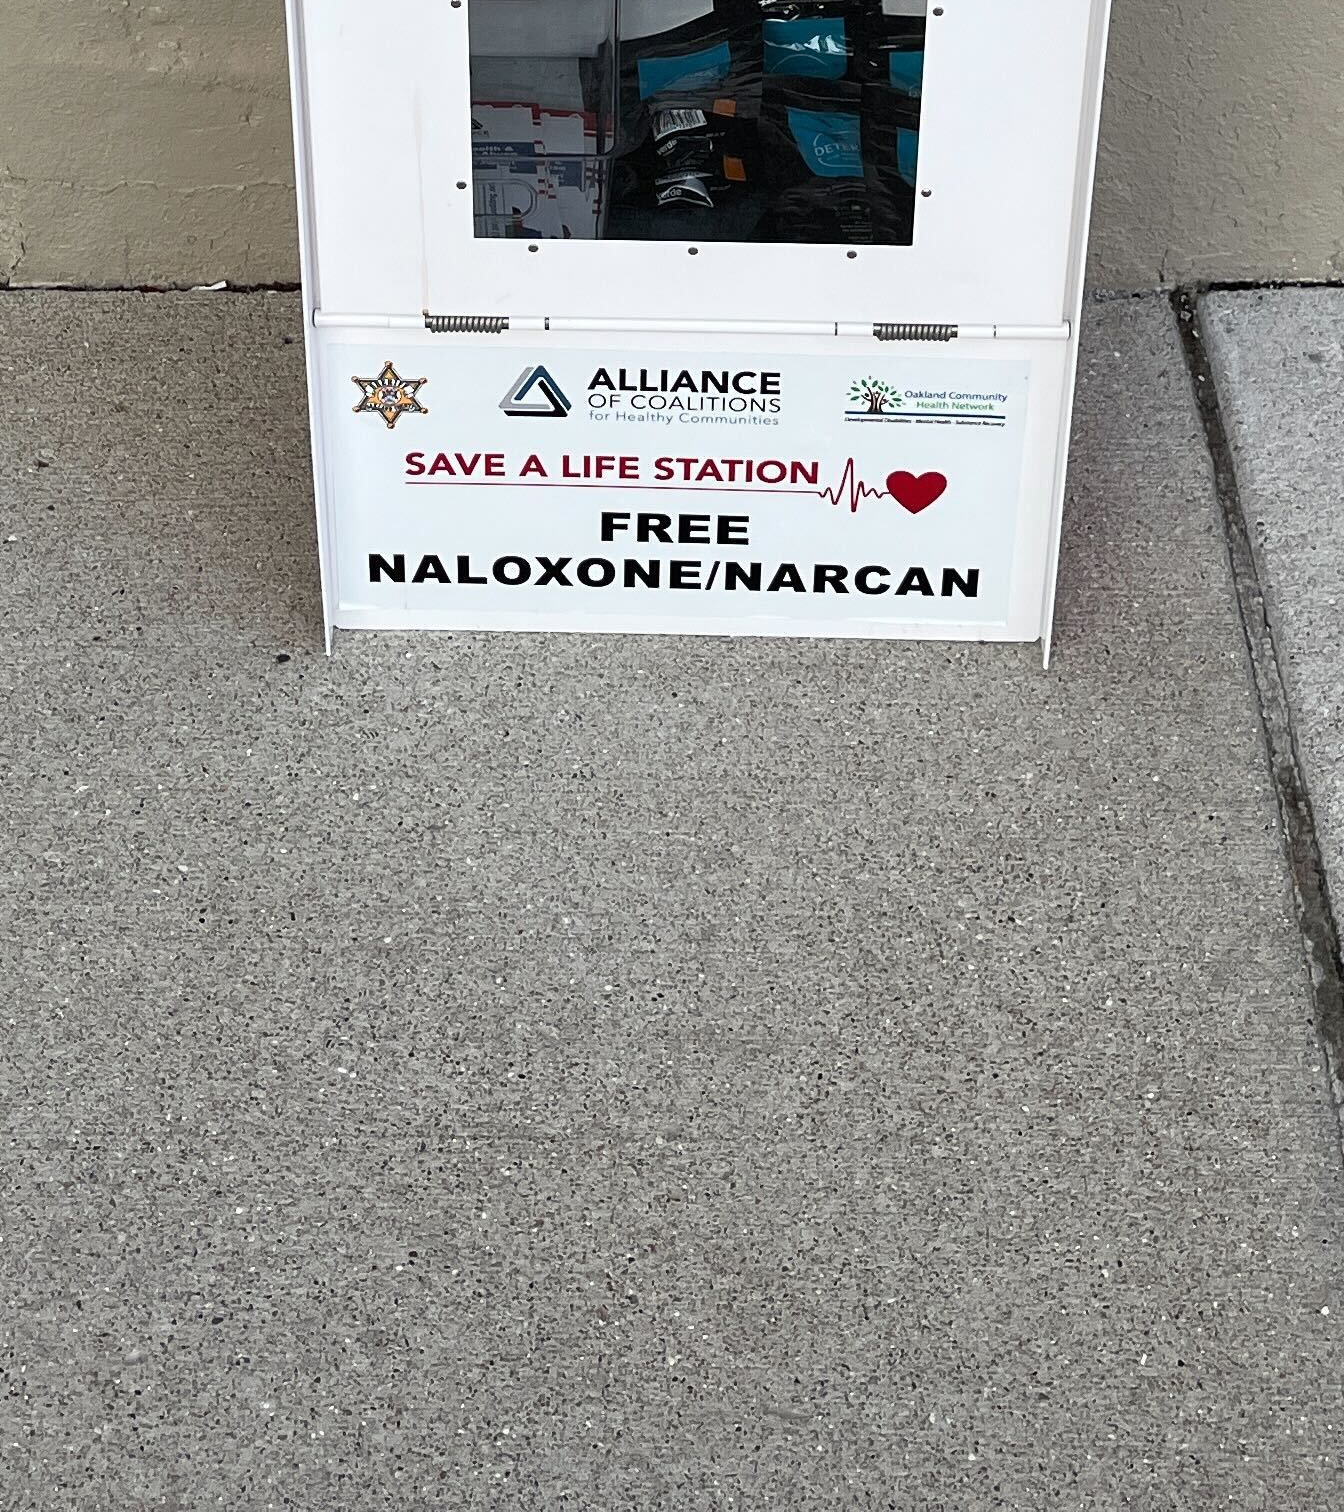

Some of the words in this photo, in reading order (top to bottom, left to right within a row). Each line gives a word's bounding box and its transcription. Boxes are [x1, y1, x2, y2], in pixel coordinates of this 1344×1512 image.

[587, 367, 781, 395] ALLIANCE
[588, 393, 621, 409] OF
[630, 394, 781, 413] COALITIONS
[904, 390, 946, 400] Oakland
[948, 391, 1008, 402] Community
[916, 401, 949, 410] Health
[951, 402, 995, 411] Network
[589, 410, 609, 421] for
[616, 411, 673, 425] Healthy
[679, 412, 779, 426] Communities
[405, 452, 506, 476] SAVE
[519, 454, 548, 477] A
[562, 455, 640, 479] LIFE
[654, 457, 819, 485] STATION
[601, 511, 750, 546] FREE
[368, 553, 980, 598] NALOXONE/NARCAN
